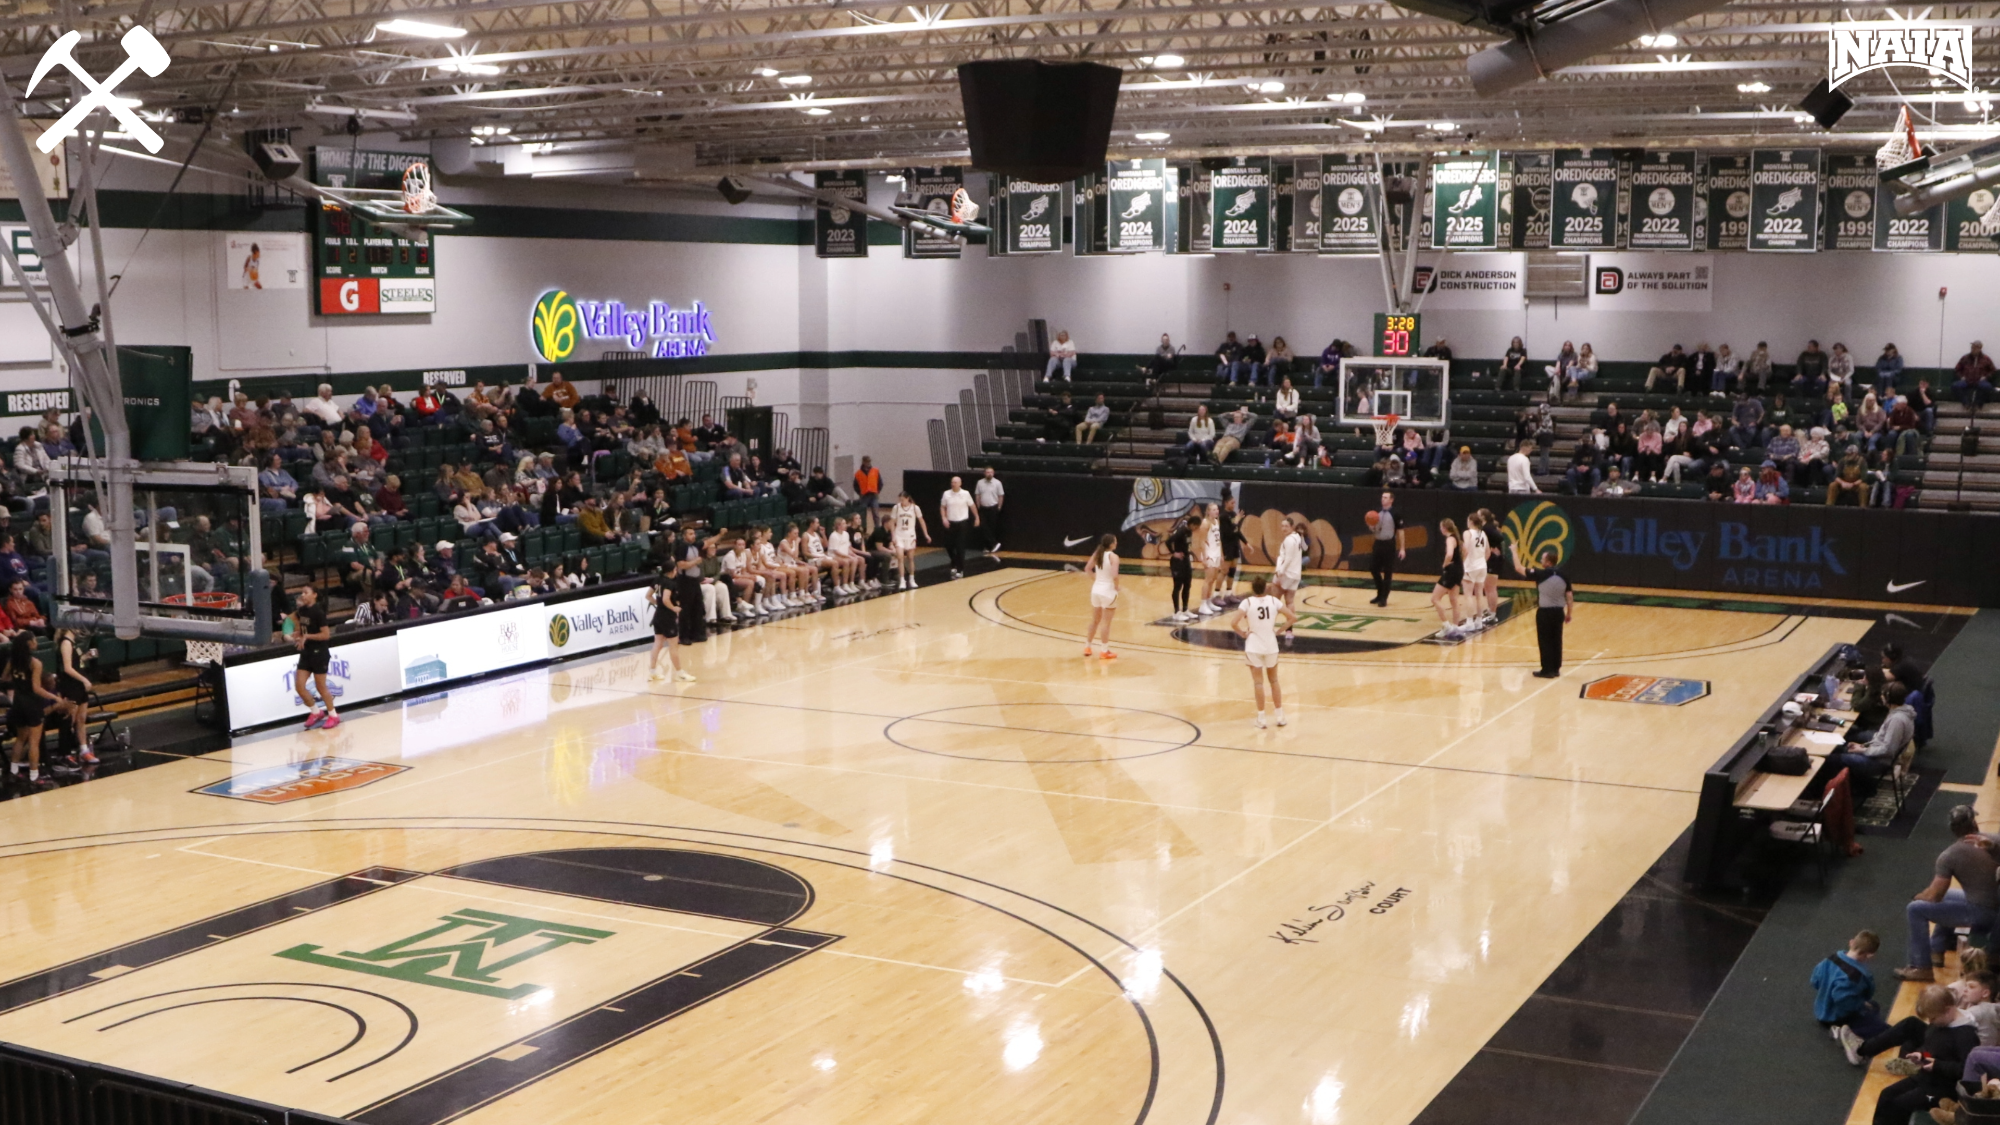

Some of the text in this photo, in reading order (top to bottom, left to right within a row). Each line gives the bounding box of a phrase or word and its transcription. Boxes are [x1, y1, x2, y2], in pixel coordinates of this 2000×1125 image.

[320, 150, 351, 168] HOME
[354, 152, 366, 168] OF
[368, 153, 386, 170] THE
[1214, 175, 1269, 188] OREDIGGERS
[1436, 169, 1496, 184] OREDIGGERS
[1554, 168, 1617, 182] OREDIGGERS
[1632, 172, 1694, 186] OREDIGGERS
[1754, 171, 1817, 185] OREDIGGERS
[1110, 177, 1163, 190] OREDIGGERS
[1019, 224, 1051, 237] 2024
[1120, 221, 1153, 236] 2024
[1223, 219, 1258, 234] 2024
[1333, 217, 1369, 232] 2025
[1446, 216, 1484, 232] 2025
[1564, 216, 1603, 232] 2025
[1642, 217, 1680, 233] 2022
[1763, 218, 1803, 234] 2022
[1888, 218, 1930, 235] 2022
[325, 237, 342, 246] FOULS
[827, 229, 855, 242] 2023
[1222, 237, 1258, 245] CHAMPIONS
[1563, 236, 1603, 244] CHAMPIONS
[1887, 240, 1930, 248] CHAMPIONS
[326, 265, 342, 275] SCORE
[1440, 270, 1517, 279] DICK ANDERSON
[1627, 272, 1692, 280] ALWAYS PART
[1440, 281, 1517, 290] CONSTRUCTION
[1627, 282, 1708, 290] OF THE SOLUTION
[340, 280, 360, 311] G
[381, 287, 434, 303] STEELE'S
[577, 300, 719, 349] Valley Bank
[1386, 316, 1415, 331] 3:28
[654, 339, 708, 358] ARENA
[1383, 330, 1409, 355] 30
[423, 370, 467, 386] RESERVED
[7, 391, 70, 413] RESERVED
[1475, 537, 1485, 548] 24
[1579, 515, 1847, 575] Valley Bank
[1722, 567, 1822, 590] ARENA
[570, 604, 640, 634] Valley Bank
[1257, 606, 1271, 620] 31
[609, 622, 635, 636] ARENA
[1368, 886, 1413, 915] COURT
